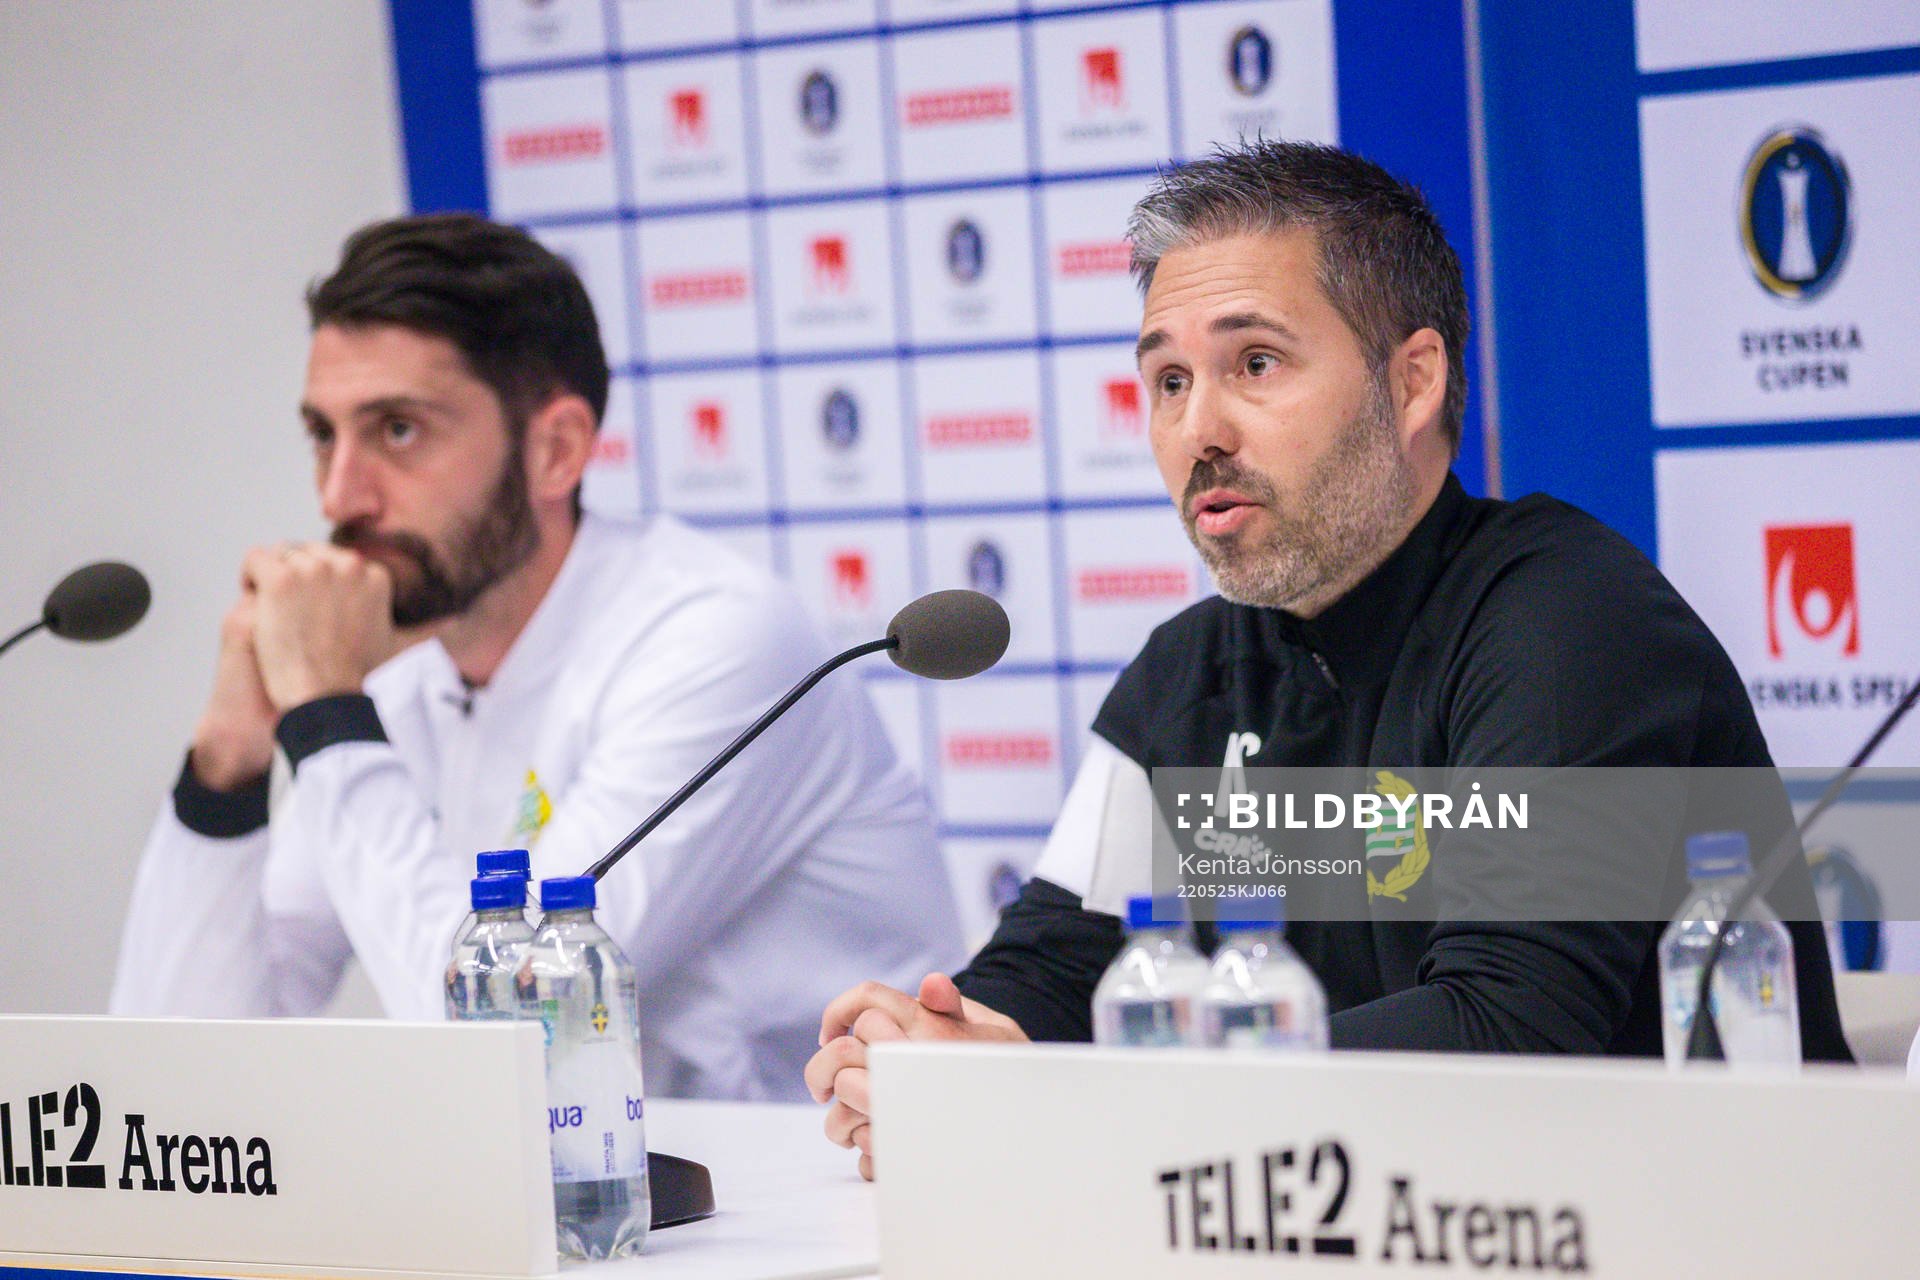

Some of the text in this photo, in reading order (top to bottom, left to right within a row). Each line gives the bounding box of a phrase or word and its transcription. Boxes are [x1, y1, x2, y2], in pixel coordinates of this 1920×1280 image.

[1740, 325, 1862, 356] SVENSKA
[1757, 361, 1848, 390] CUPEN
[1750, 679, 1841, 707] ENSKA
[0, 1082, 277, 1196] LE2 Arena
[1157, 1141, 1590, 1273] TELE2 Arena
